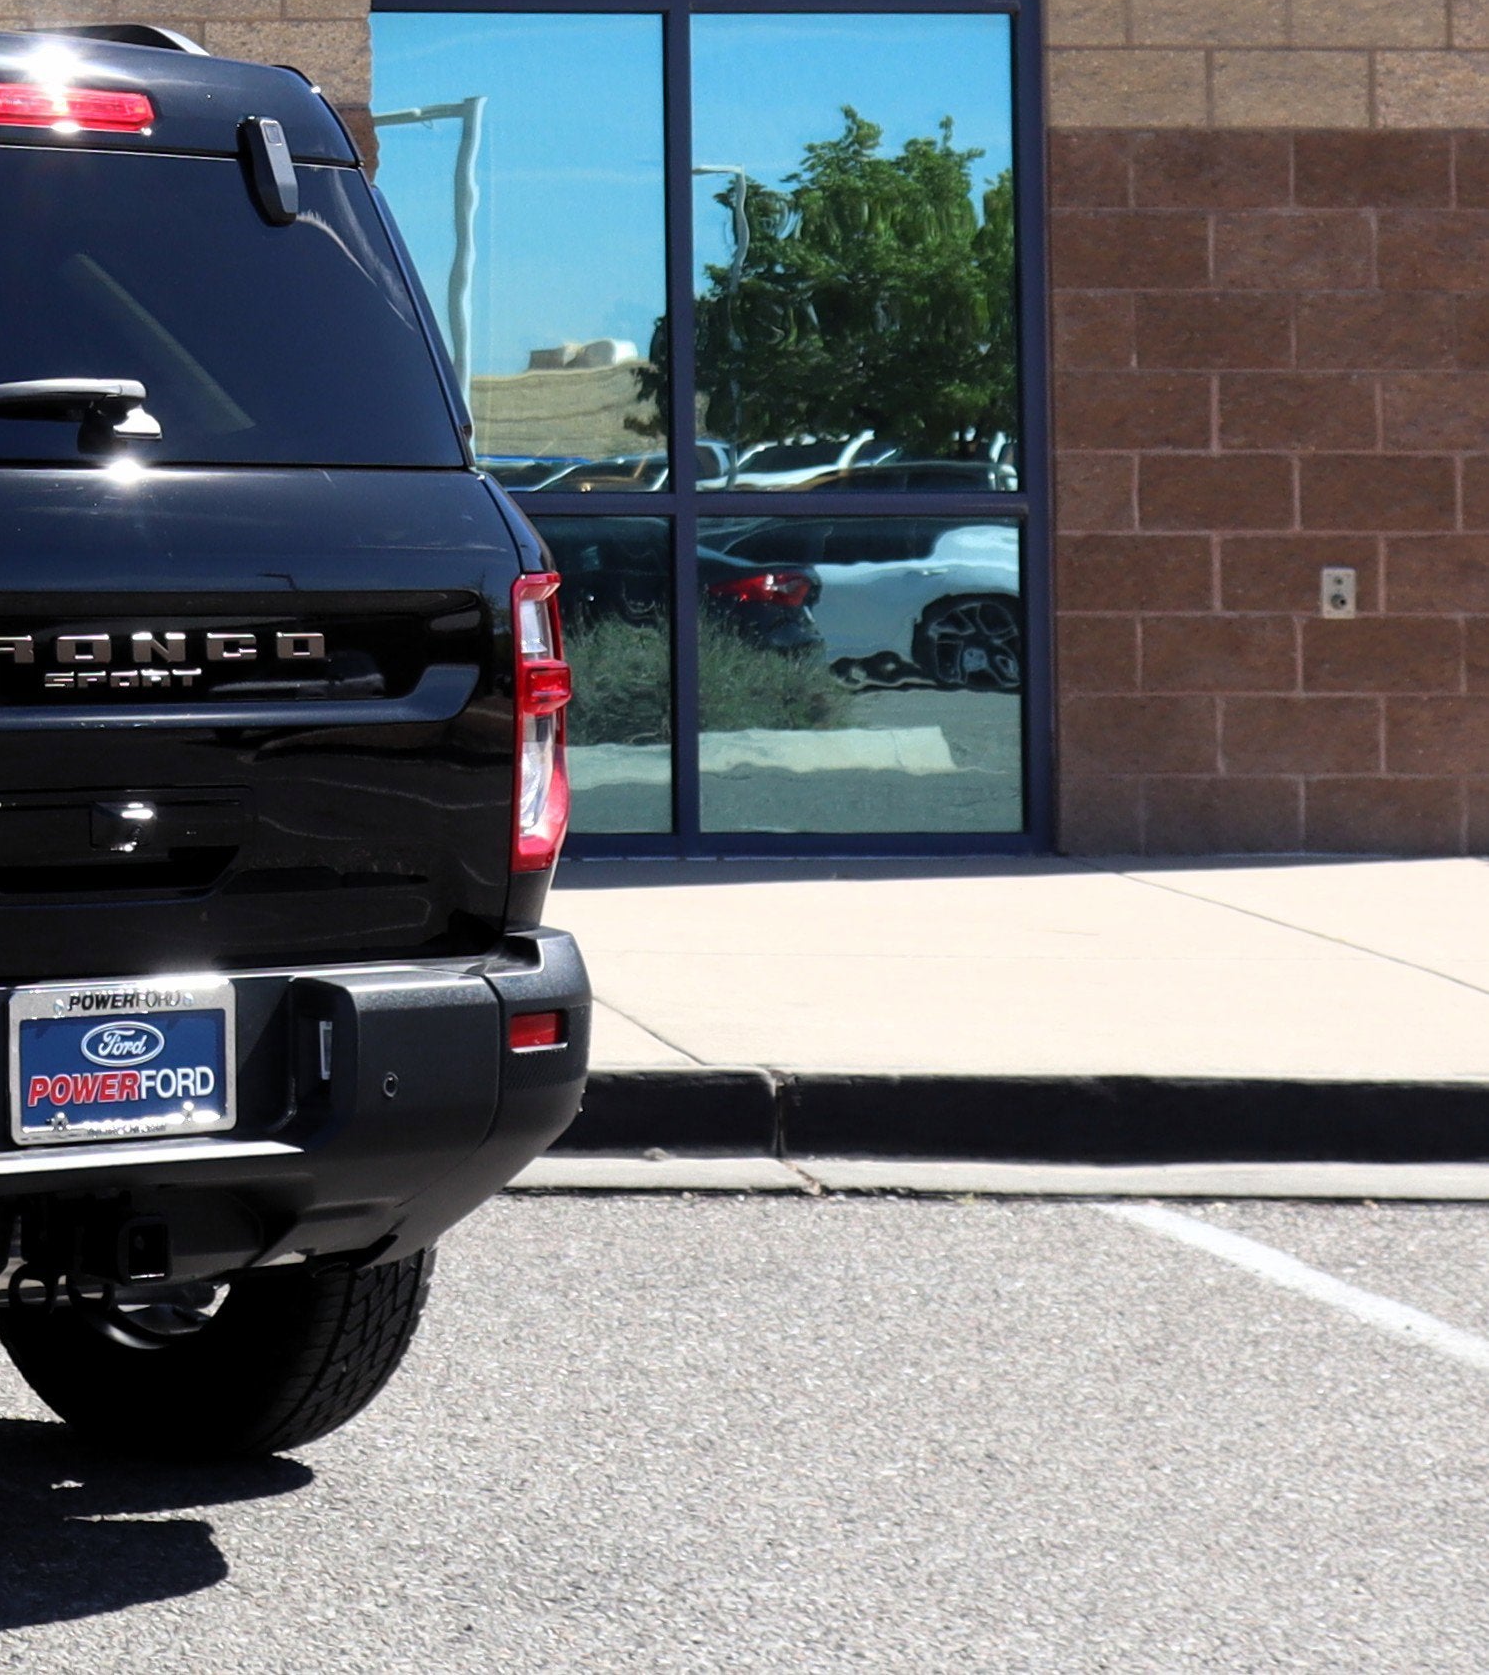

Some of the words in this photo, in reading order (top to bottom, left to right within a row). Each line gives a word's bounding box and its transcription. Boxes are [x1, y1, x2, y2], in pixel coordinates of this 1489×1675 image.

[44, 668, 202, 688] SPORT
[68, 989, 181, 1012] POWERFORD
[98, 1028, 147, 1056] Ford
[27, 1066, 215, 1107] POWERFORD
